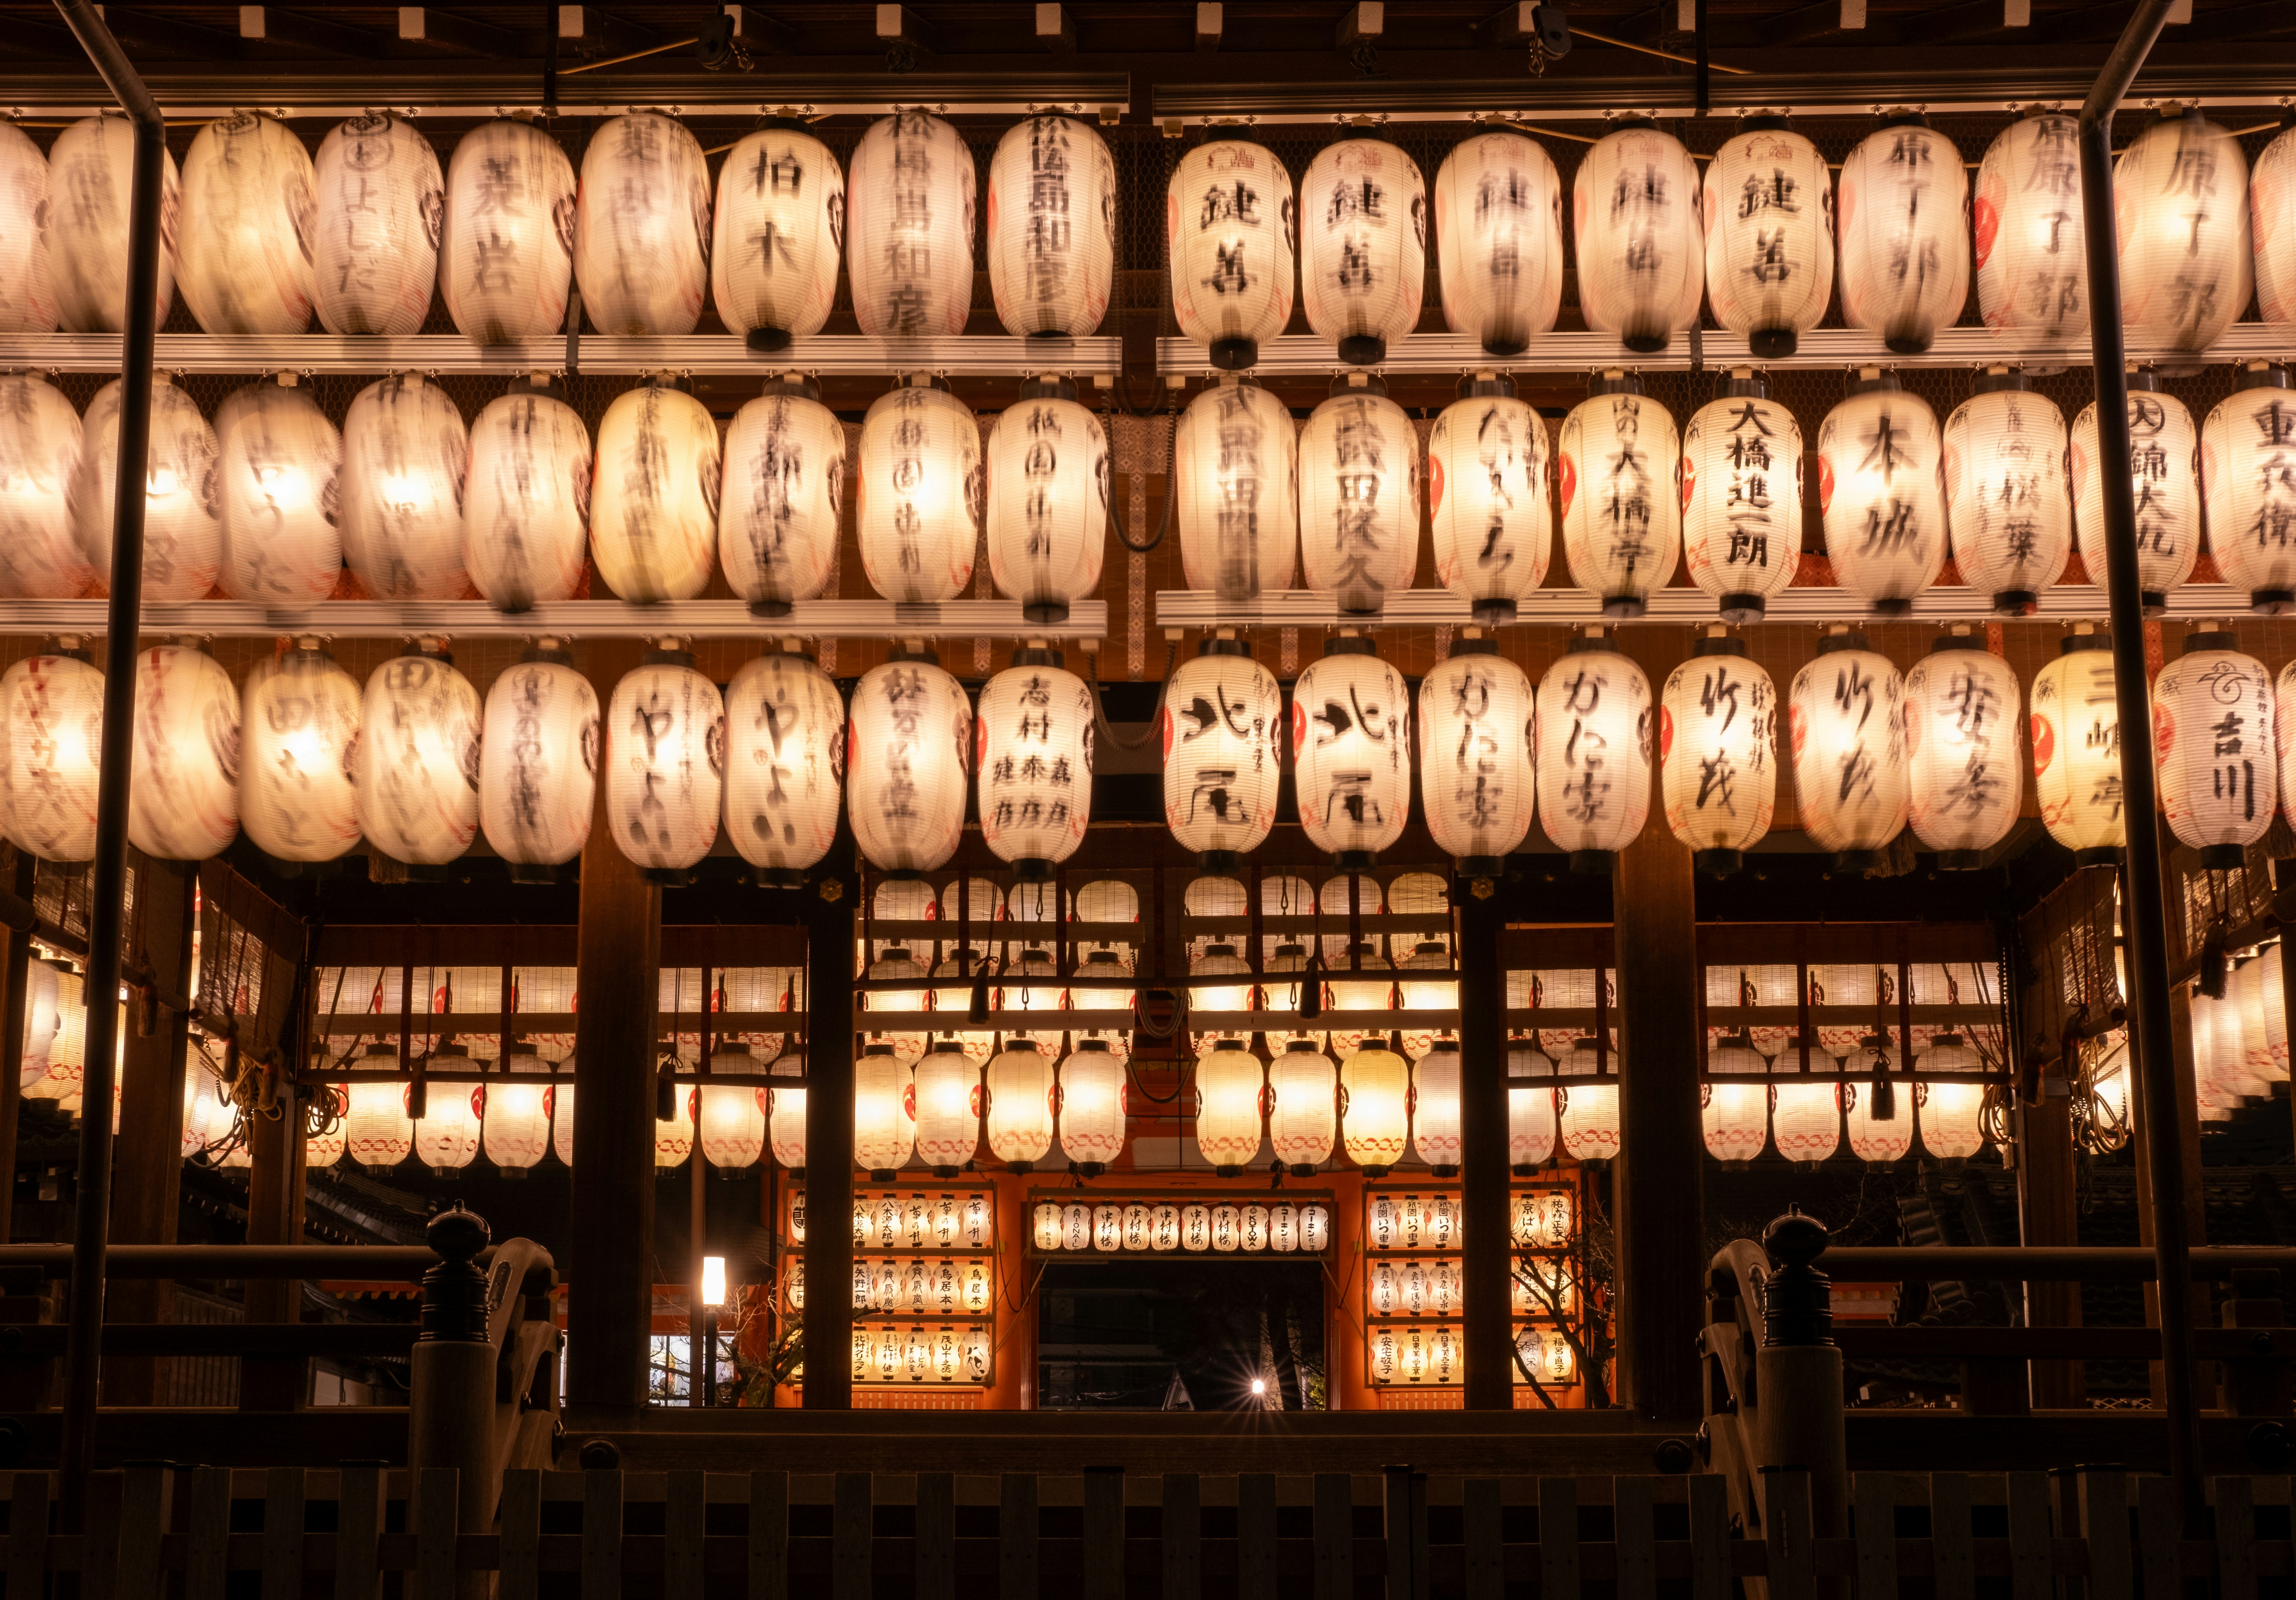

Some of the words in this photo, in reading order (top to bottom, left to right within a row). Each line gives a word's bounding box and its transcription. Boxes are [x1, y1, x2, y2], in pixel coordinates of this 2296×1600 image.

[2210, 711, 2255, 822] 吉川
[882, 1200, 894, 1241] 八木源太郎
[1247, 1215, 1258, 1247] KOTOWA
[855, 1267, 866, 1304] 矢野一郎
[939, 1268, 953, 1305] 鳥居本
[971, 1268, 982, 1305] 鳥居本
[854, 1334, 865, 1371] 北村クリニック
[941, 1335, 952, 1373] 茂山千之丞
[1553, 1337, 1565, 1373] 福呂直子
